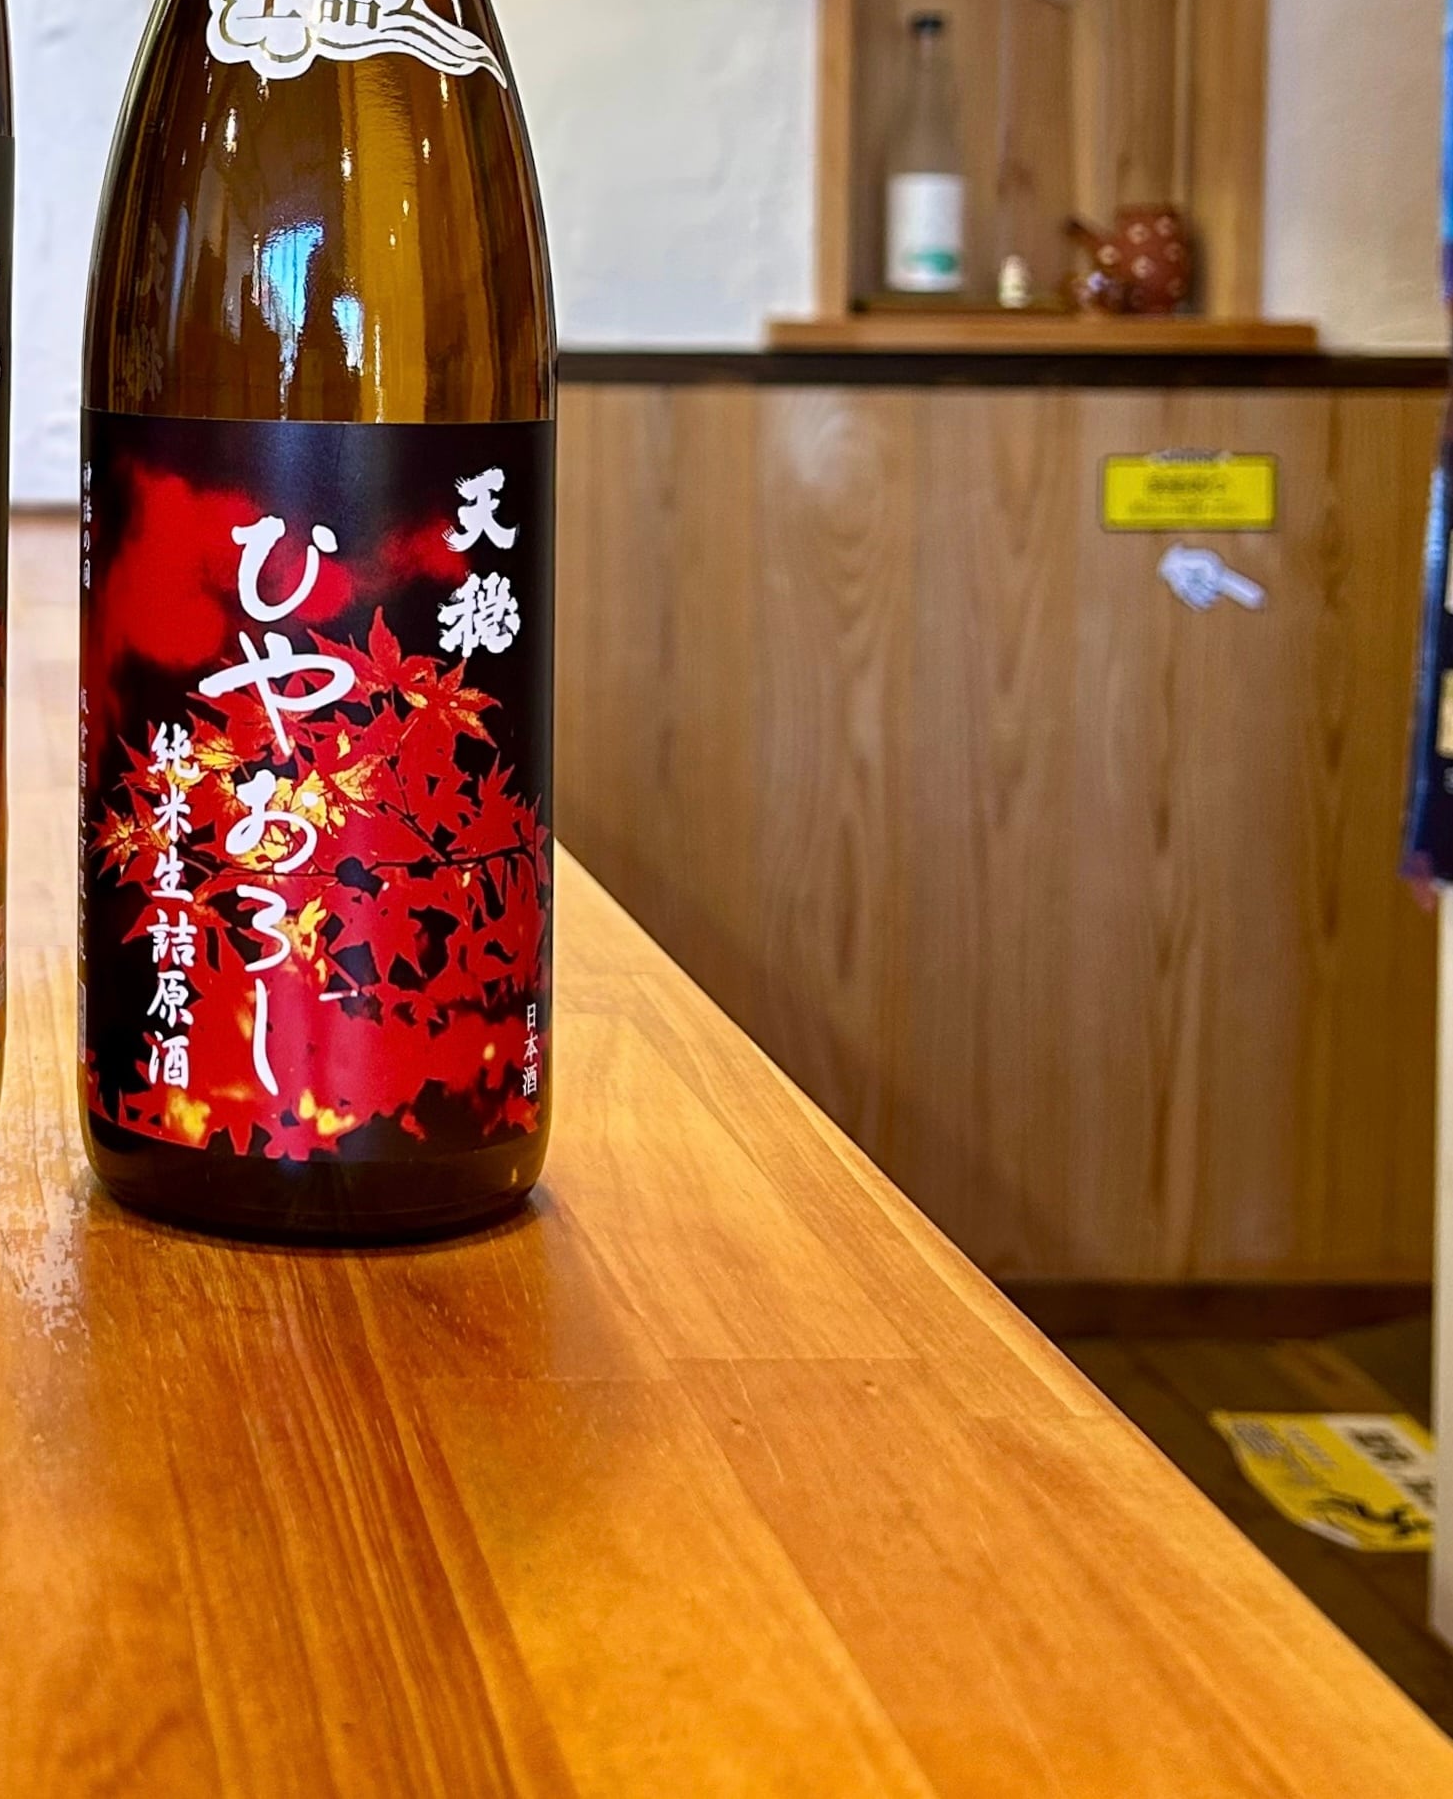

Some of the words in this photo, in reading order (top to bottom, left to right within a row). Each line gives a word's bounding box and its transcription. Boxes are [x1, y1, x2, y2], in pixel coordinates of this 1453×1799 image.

[145, 720, 200, 1091] 純米生詰原酒
[197, 514, 358, 1097] ひやおろし
[522, 1002, 539, 1098] 日本酒
